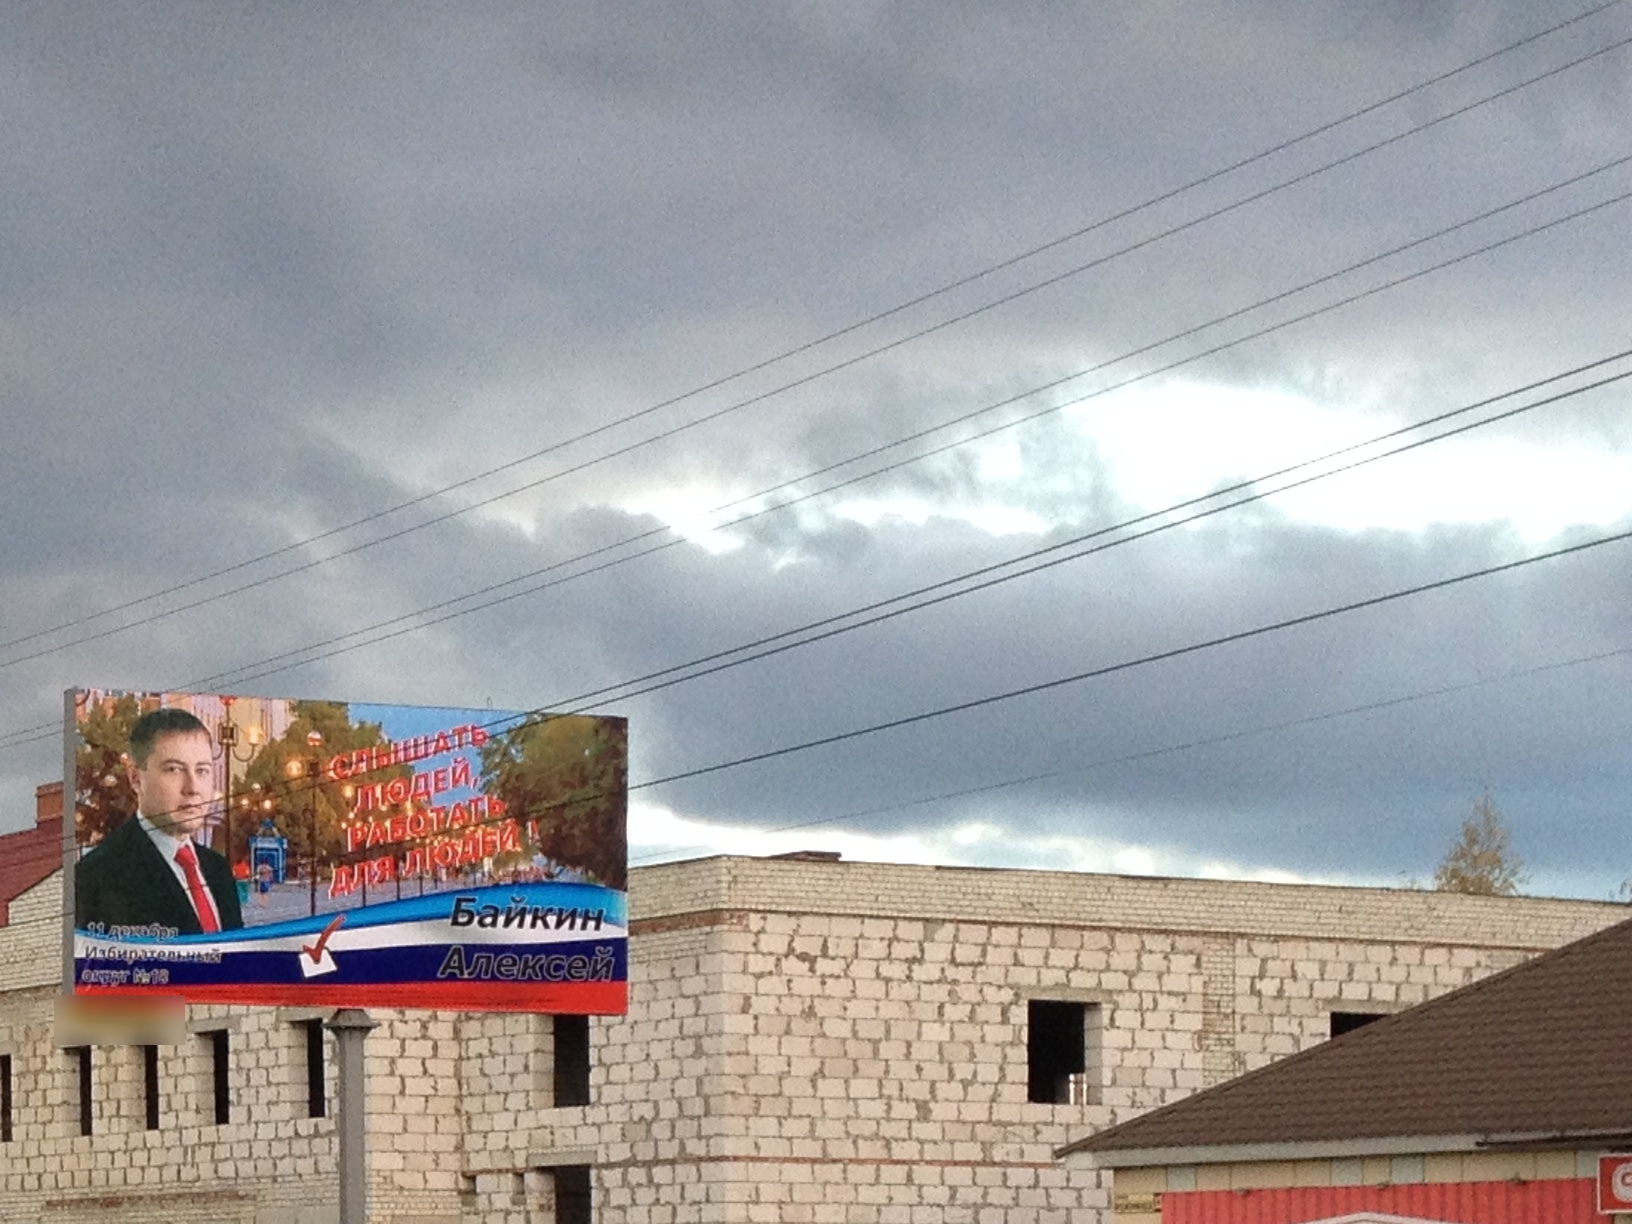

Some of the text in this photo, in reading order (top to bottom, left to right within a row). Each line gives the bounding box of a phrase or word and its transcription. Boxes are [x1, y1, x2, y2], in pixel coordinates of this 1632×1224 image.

[328, 724, 489, 780] СЛЫШАТЬ
[347, 795, 508, 852] РАБОТАТЬ
[328, 855, 397, 900] ДЛЯ
[87, 922, 179, 942] 11 декабря
[450, 896, 605, 932] Байкин
[85, 945, 222, 965] Избирательный
[437, 945, 615, 982] Алексей
[82, 969, 130, 987] округ
